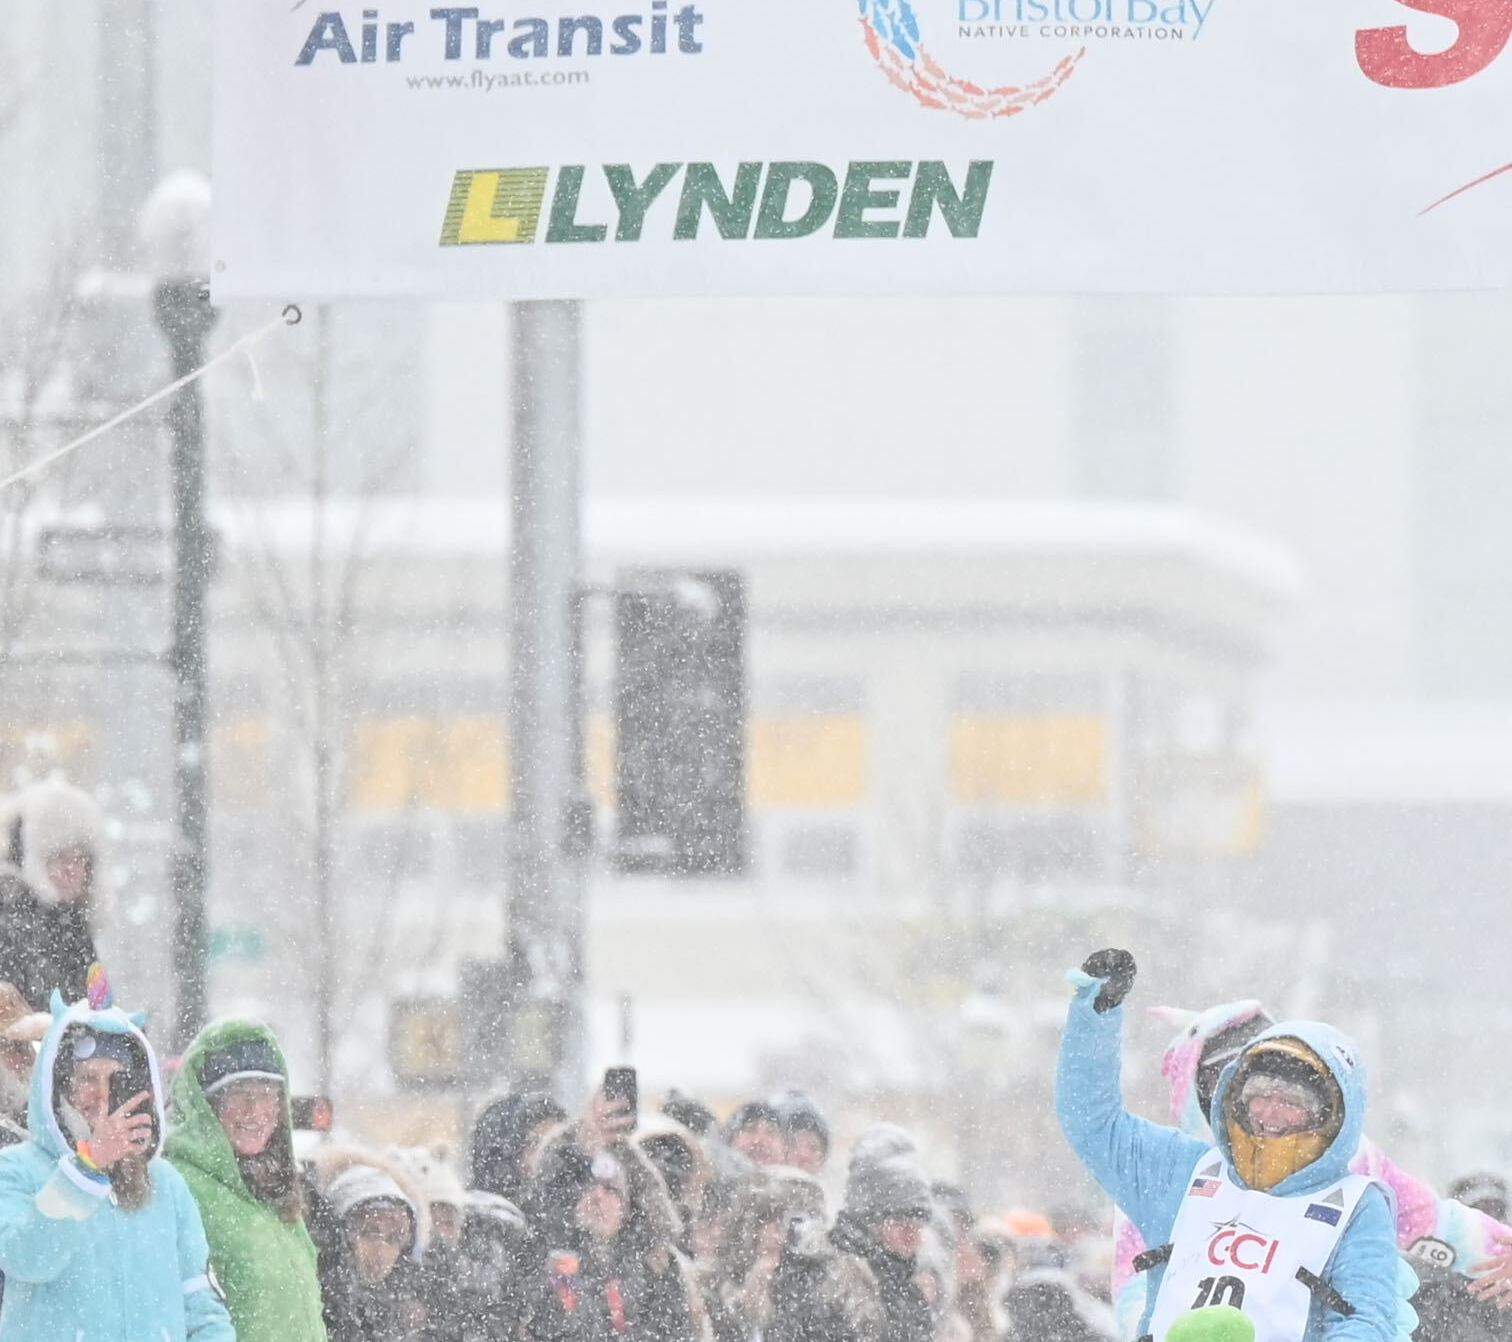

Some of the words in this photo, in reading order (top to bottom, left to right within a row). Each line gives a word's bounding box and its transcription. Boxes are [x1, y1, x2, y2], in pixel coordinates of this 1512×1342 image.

[294, 9, 415, 67] Air
[430, 0, 705, 60] Transit
[958, 24, 1030, 38] NATIVE
[1039, 25, 1184, 40] CORPORATION
[405, 68, 590, 93] www.flyaat.com
[545, 158, 995, 244] LYNDEN
[1207, 1230, 1280, 1274] GCI
